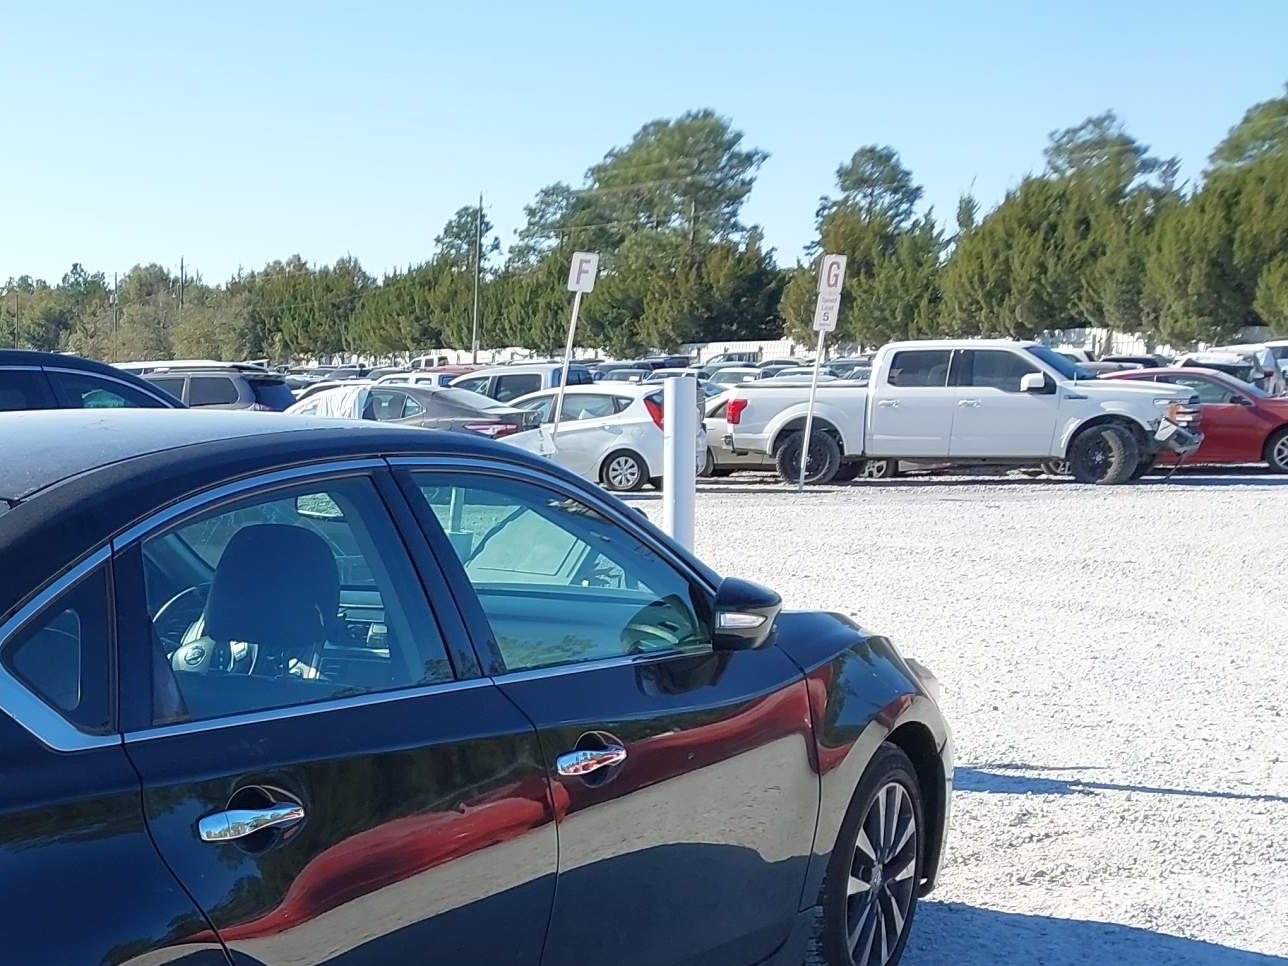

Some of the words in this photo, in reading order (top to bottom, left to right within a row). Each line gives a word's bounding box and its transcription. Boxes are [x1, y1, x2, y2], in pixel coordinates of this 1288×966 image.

[575, 259, 591, 285] F
[827, 260, 841, 288] G
[822, 312, 830, 322] 5
